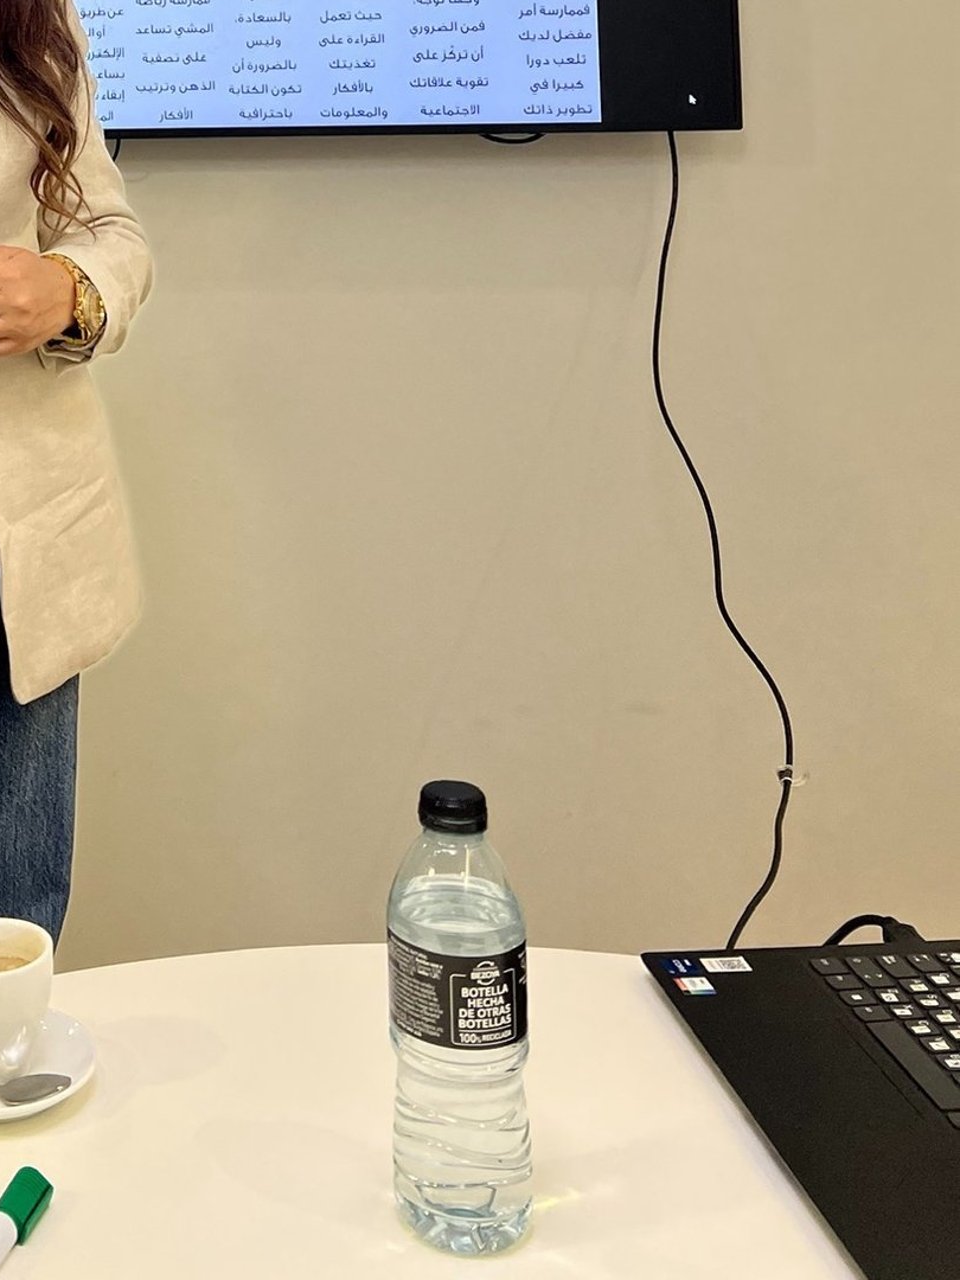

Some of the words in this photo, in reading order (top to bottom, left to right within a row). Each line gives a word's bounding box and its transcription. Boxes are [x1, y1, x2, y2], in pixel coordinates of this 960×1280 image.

[79, 7, 106, 20] طريق
[107, 7, 124, 19] عن
[319, 10, 352, 24] تعمل
[354, 10, 383, 22] حيث
[518, 3, 537, 20] أمر
[539, 4, 591, 19] فممارسة
[135, 24, 172, 35] تساعد
[174, 23, 214, 39] المشي
[409, 21, 458, 38] الضروري
[460, 19, 486, 34] فمن
[245, 35, 282, 49] وليس
[318, 34, 344, 48] على
[346, 33, 385, 47] القراءة
[518, 29, 550, 42] لديك
[552, 29, 592, 43] مفضل
[141, 52, 180, 64] تصفية
[182, 51, 207, 65] على
[412, 49, 439, 64] على
[470, 44, 484, 63] أن
[526, 53, 550, 68] دورا
[552, 52, 587, 67] تلعب
[231, 57, 245, 74] أن
[247, 59, 297, 73] بالضرورة
[328, 58, 376, 71] تغذيتك
[135, 82, 176, 95] وترتيب
[178, 80, 216, 95] الذهن
[332, 79, 374, 96] بالأفكار
[409, 76, 453, 88] علاقاتك
[455, 76, 489, 90] تقوية
[529, 79, 549, 96] في
[552, 78, 584, 93] كبيرا
[228, 83, 269, 96] الكتابة
[270, 84, 302, 97] تكون
[158, 107, 193, 123] الأفكار
[238, 107, 293, 121] باحترافية
[319, 106, 389, 120] والمعلومات
[420, 104, 480, 118] الاجتماعية
[523, 103, 553, 115] ذاتك
[555, 103, 593, 117] تطوير
[461, 983, 509, 998] BOTELLA
[467, 996, 505, 1008] HECHA
[459, 1008, 476, 1019] DE
[476, 1003, 511, 1018] OTRAS
[458, 1013, 512, 1029] BOTELLAS
